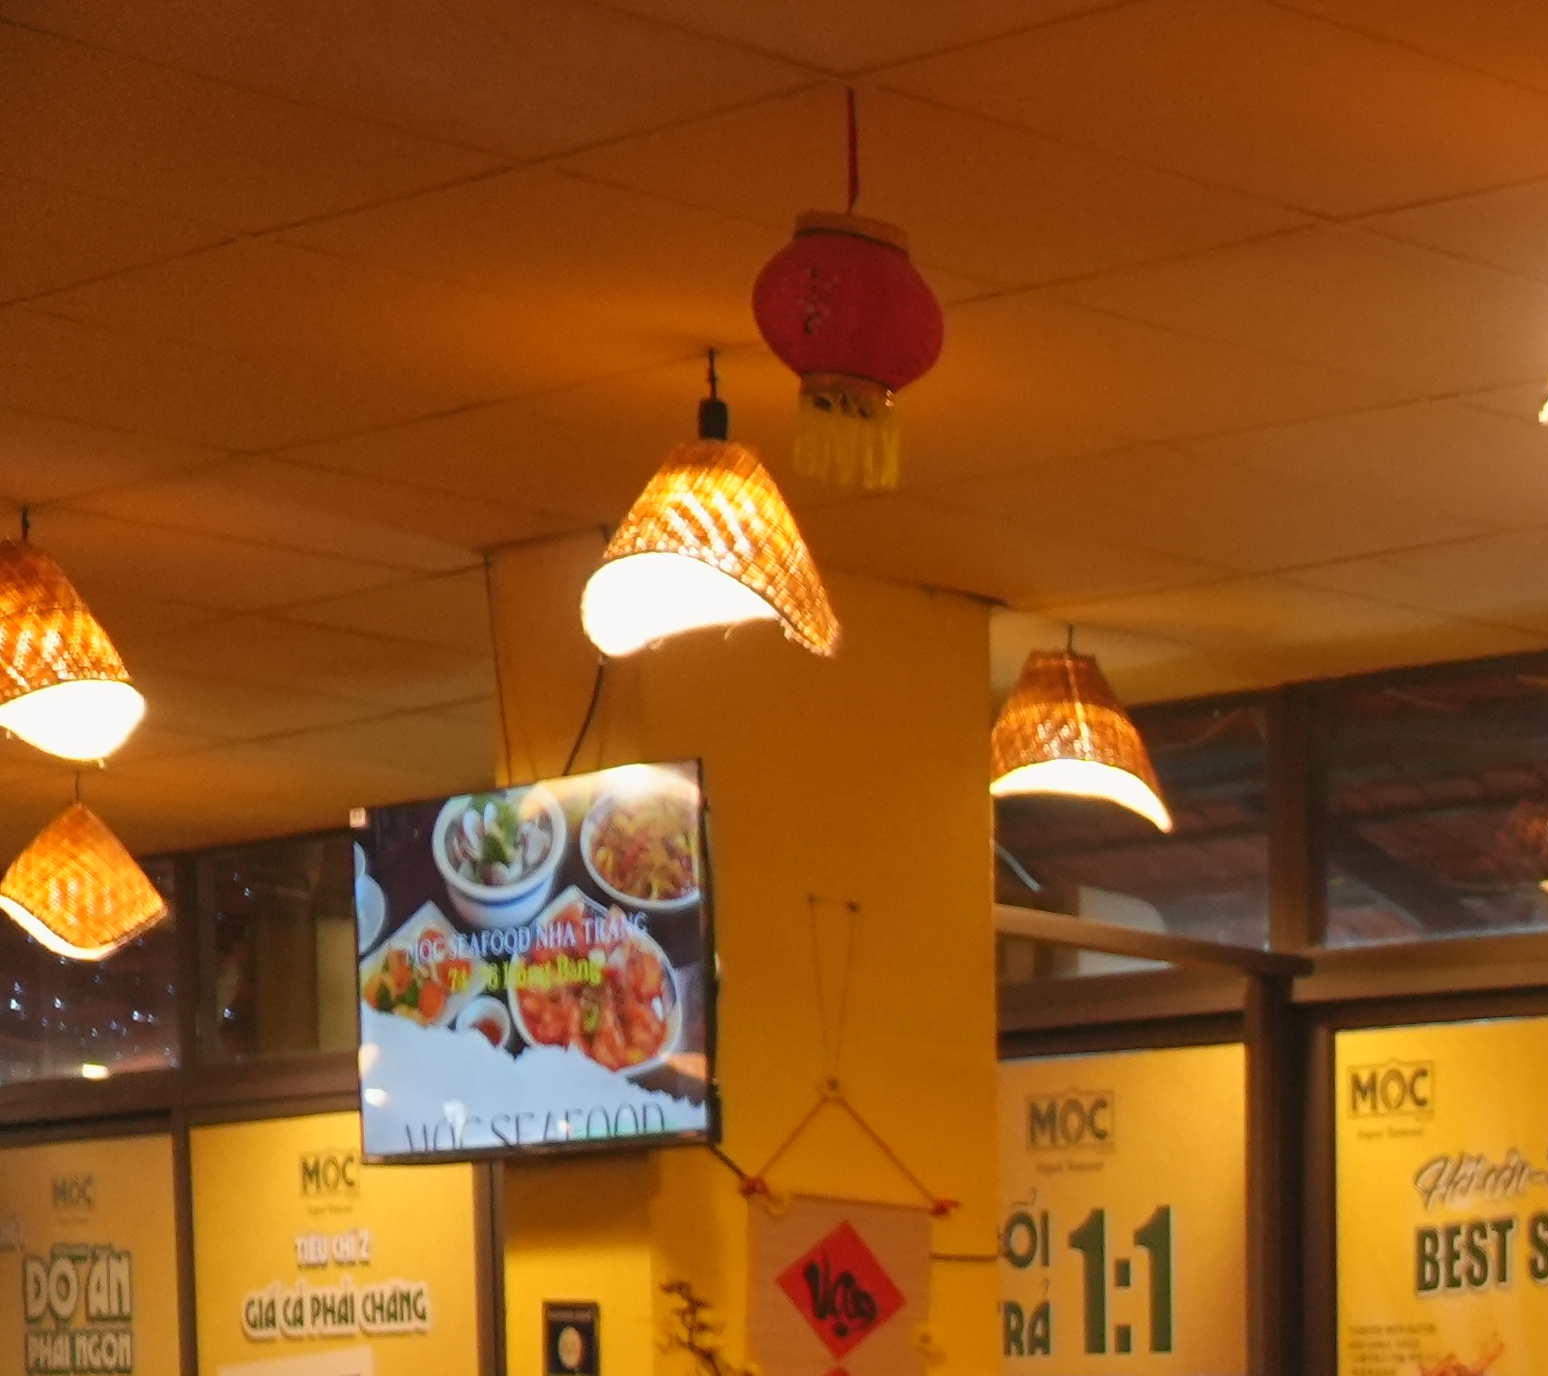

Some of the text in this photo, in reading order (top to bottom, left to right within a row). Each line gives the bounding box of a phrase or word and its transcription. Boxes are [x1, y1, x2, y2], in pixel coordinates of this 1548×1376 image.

[537, 920, 577, 949] NHA
[1067, 1205, 1173, 1355] 1:1
[1416, 1216, 1514, 1293] BEST
